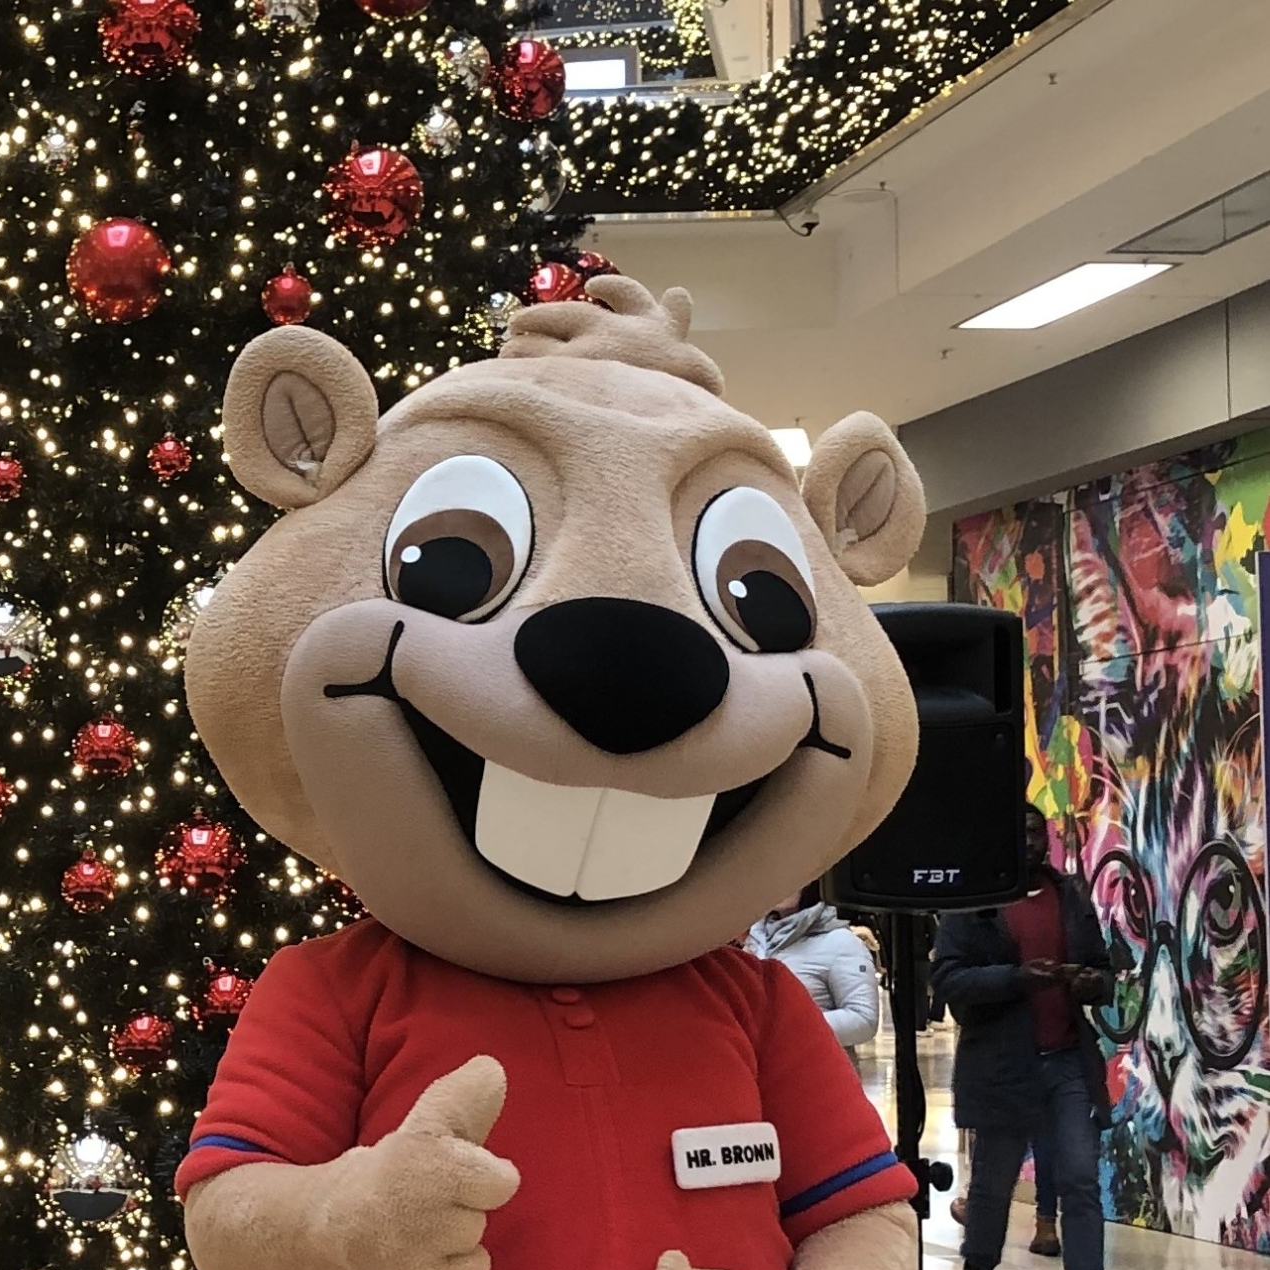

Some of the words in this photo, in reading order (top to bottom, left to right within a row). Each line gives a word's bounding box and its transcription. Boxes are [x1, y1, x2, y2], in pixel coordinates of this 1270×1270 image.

[913, 869, 961, 883] FBT
[686, 1149, 716, 1169] HR.
[721, 1142, 775, 1165] BRONN
